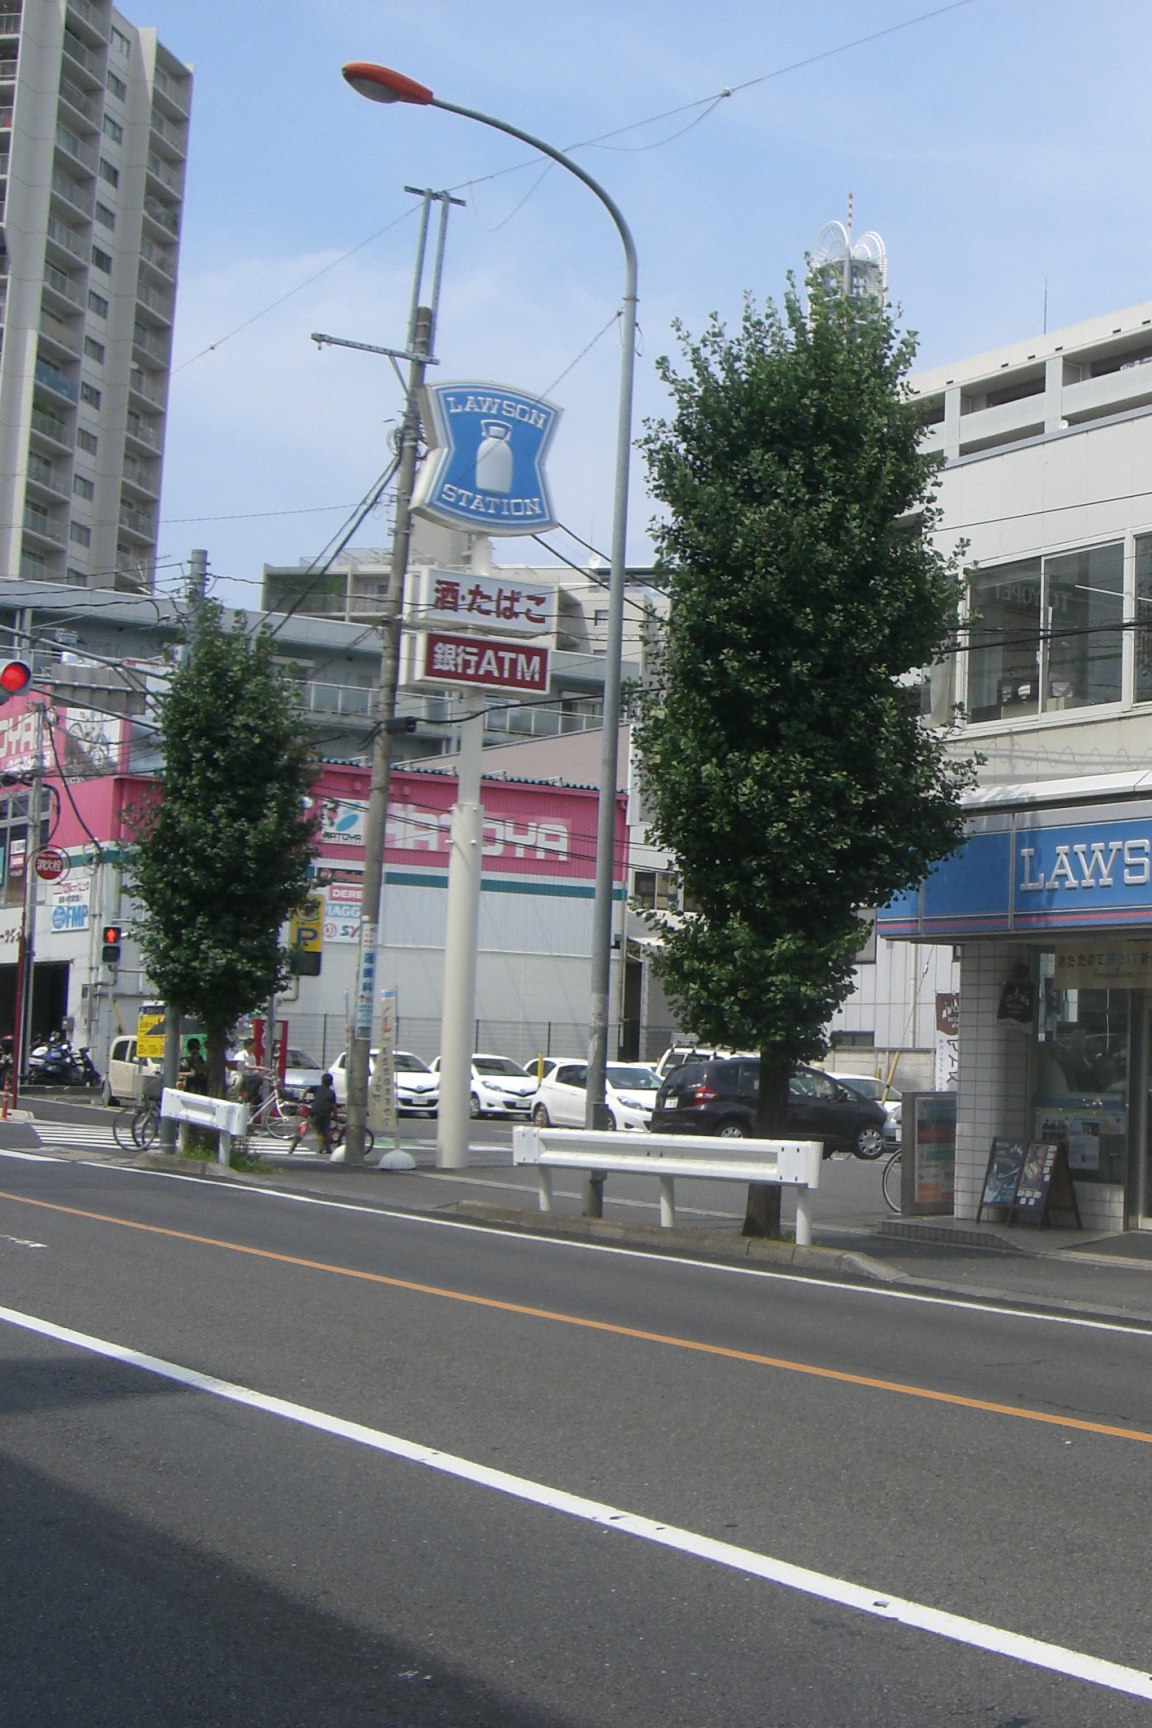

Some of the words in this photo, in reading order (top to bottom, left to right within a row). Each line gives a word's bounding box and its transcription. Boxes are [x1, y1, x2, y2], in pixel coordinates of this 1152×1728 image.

[446, 396, 547, 429] LAWSON
[441, 483, 541, 516] STATION
[433, 640, 541, 683] 銀行ATM
